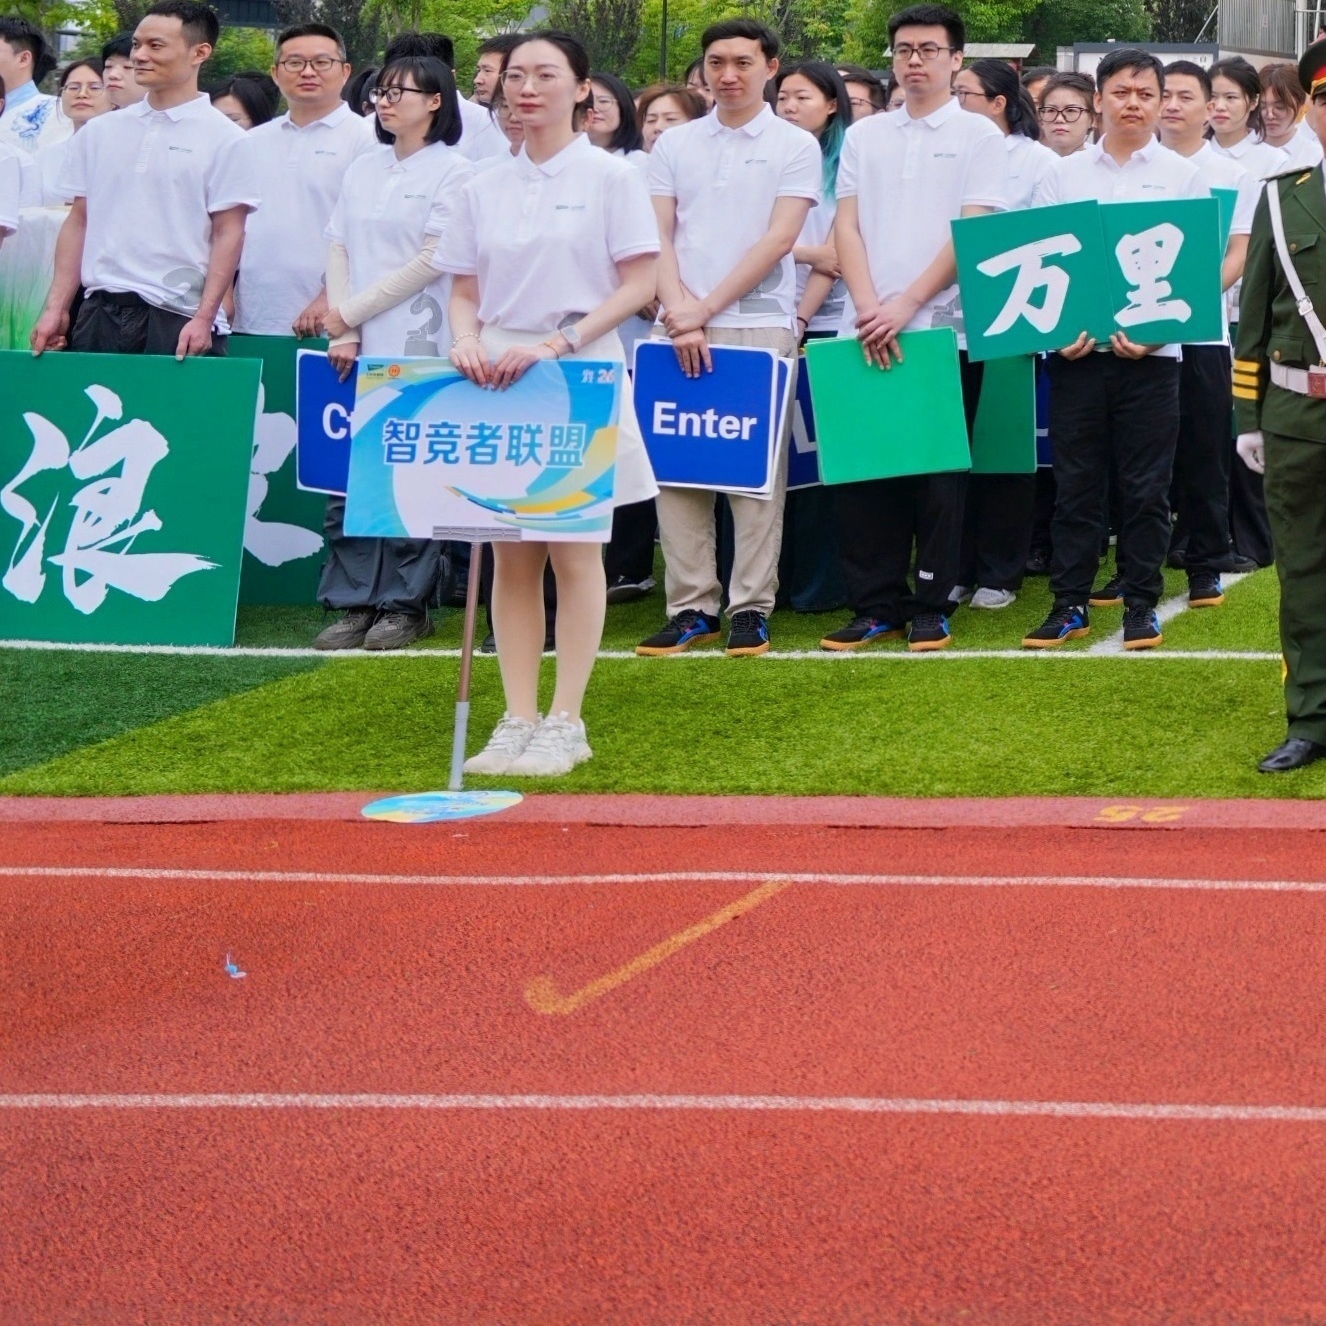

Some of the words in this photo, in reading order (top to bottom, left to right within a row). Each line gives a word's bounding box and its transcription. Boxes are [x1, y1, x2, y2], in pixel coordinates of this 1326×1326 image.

[976, 223, 1192, 337] 万里
[322, 402, 351, 439] C
[383, 419, 585, 467] 智竞者联盟
[652, 401, 758, 440] Enter
[0, 384, 223, 615] 浪
